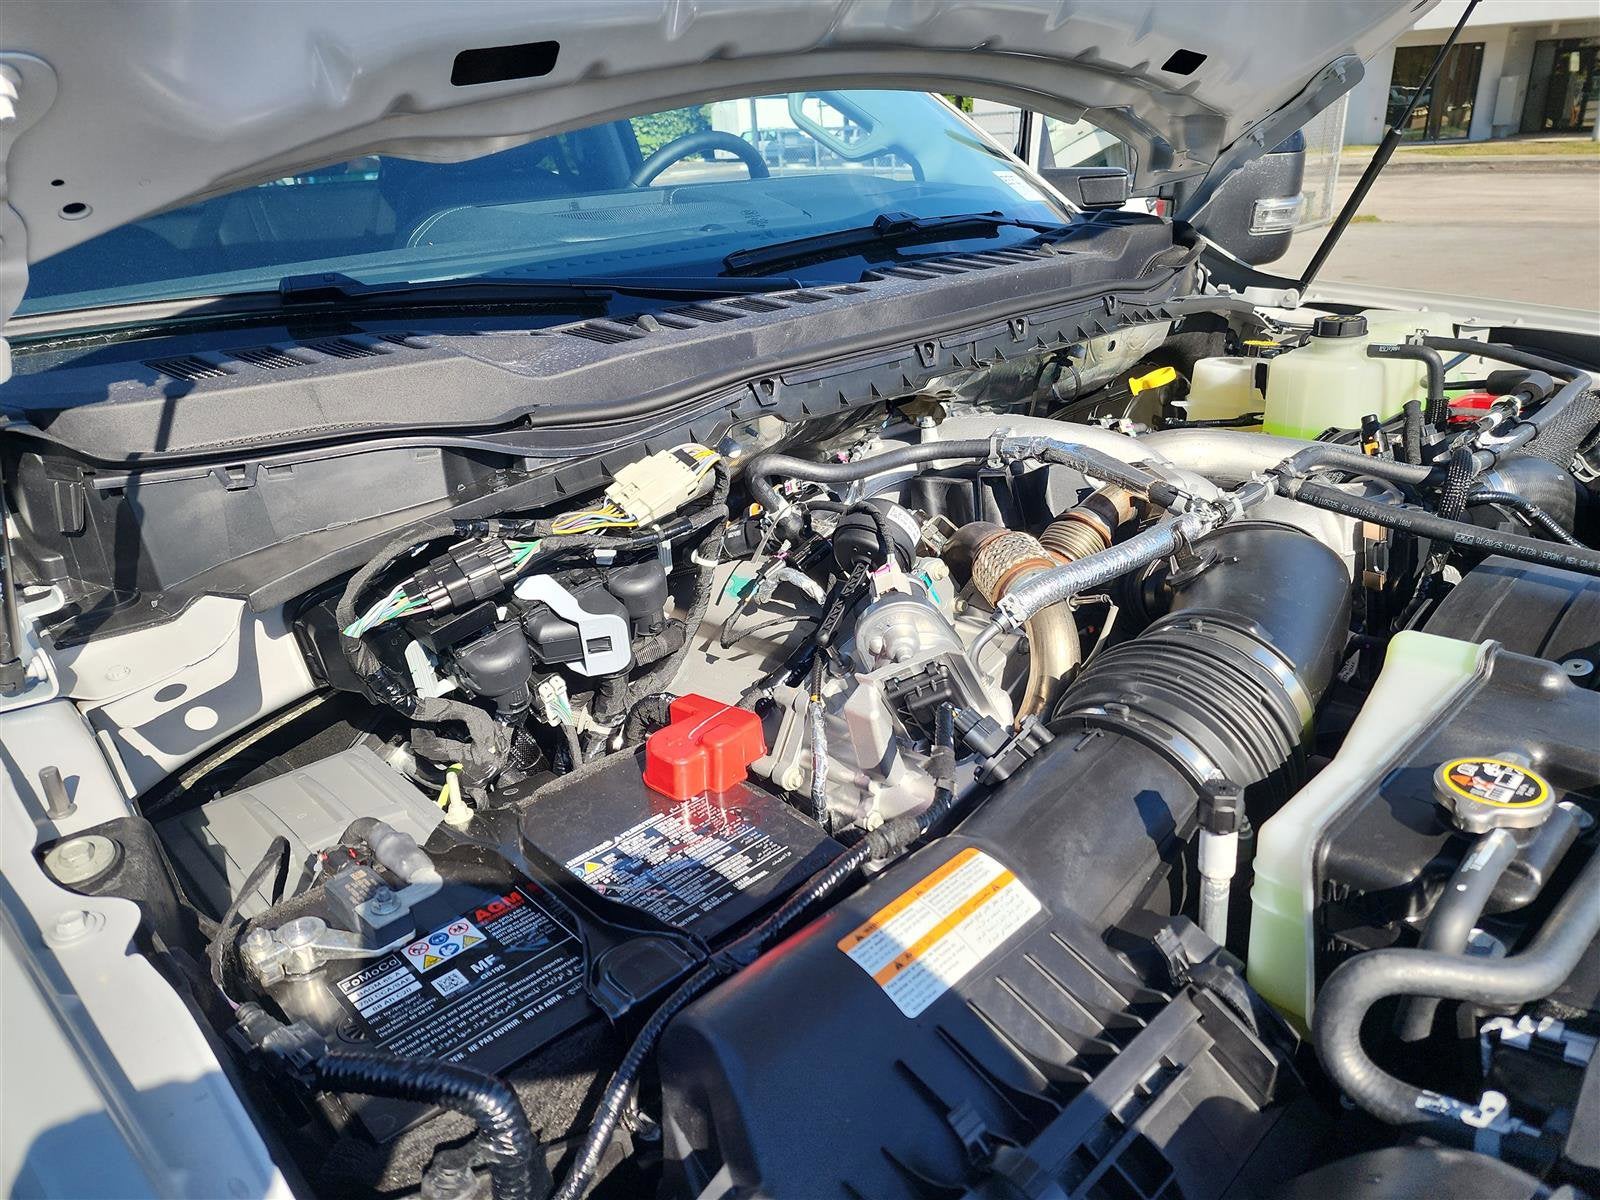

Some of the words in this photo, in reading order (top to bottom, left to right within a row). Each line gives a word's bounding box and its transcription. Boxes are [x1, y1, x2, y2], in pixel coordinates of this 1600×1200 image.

[472, 888, 523, 922] AGM
[340, 957, 398, 992] FoMoCo
[469, 953, 498, 975] MF
[383, 996, 395, 1005] Ah
[374, 1022, 390, 1033] Ford
[389, 1012, 408, 1025] Motor
[411, 1026, 425, 1038] USA
[424, 1018, 438, 1030] with
[446, 1007, 458, 1018] and
[477, 1032, 494, 1047] PAS
[522, 1008, 535, 1021] NO
